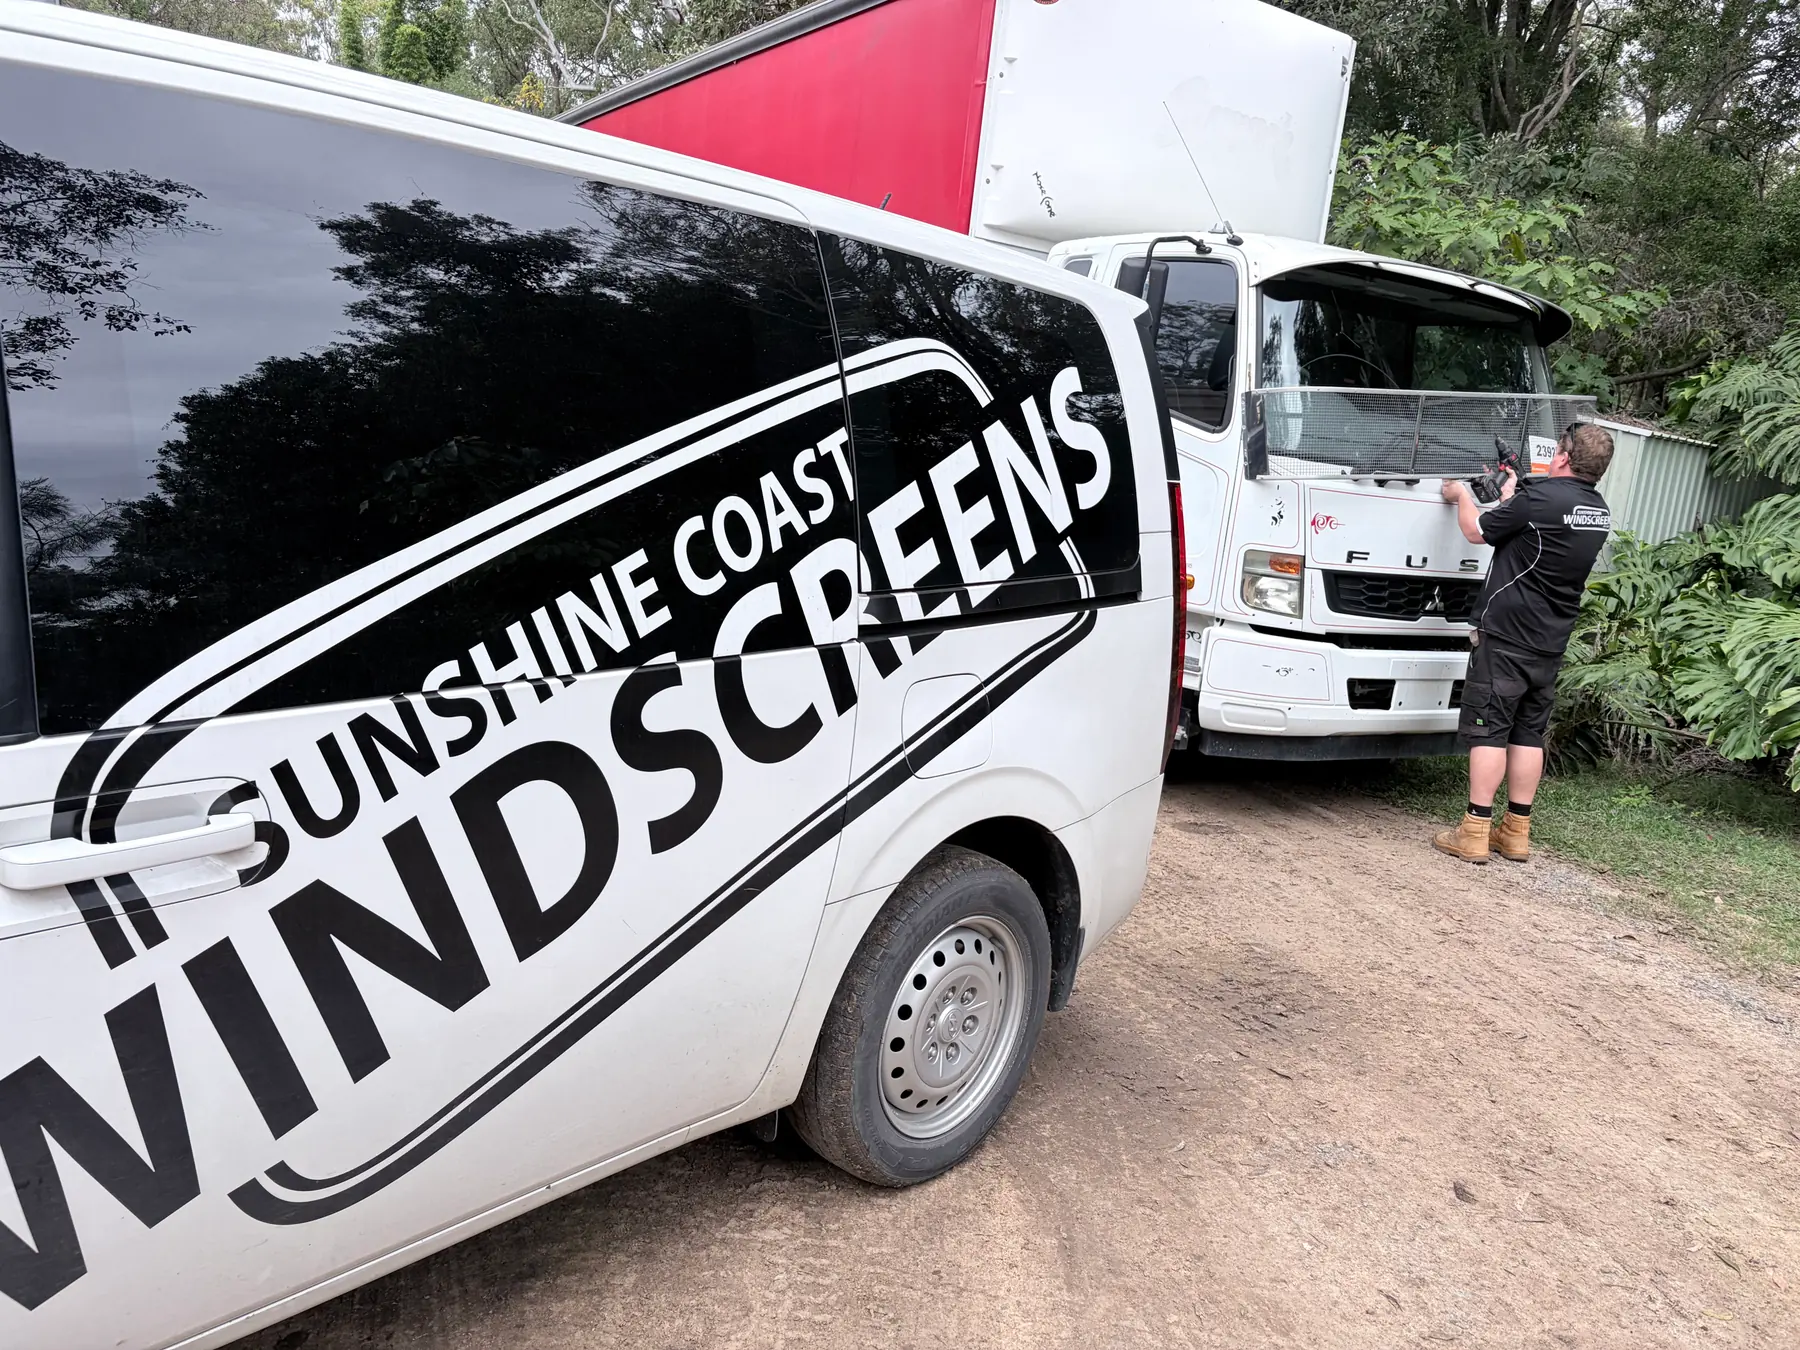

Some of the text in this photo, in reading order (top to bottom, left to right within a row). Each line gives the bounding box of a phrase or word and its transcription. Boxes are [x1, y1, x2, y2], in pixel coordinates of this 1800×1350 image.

[0, 366, 1112, 1311] WINDSCREENS
[207, 427, 855, 887] SUNSHINE COAST
